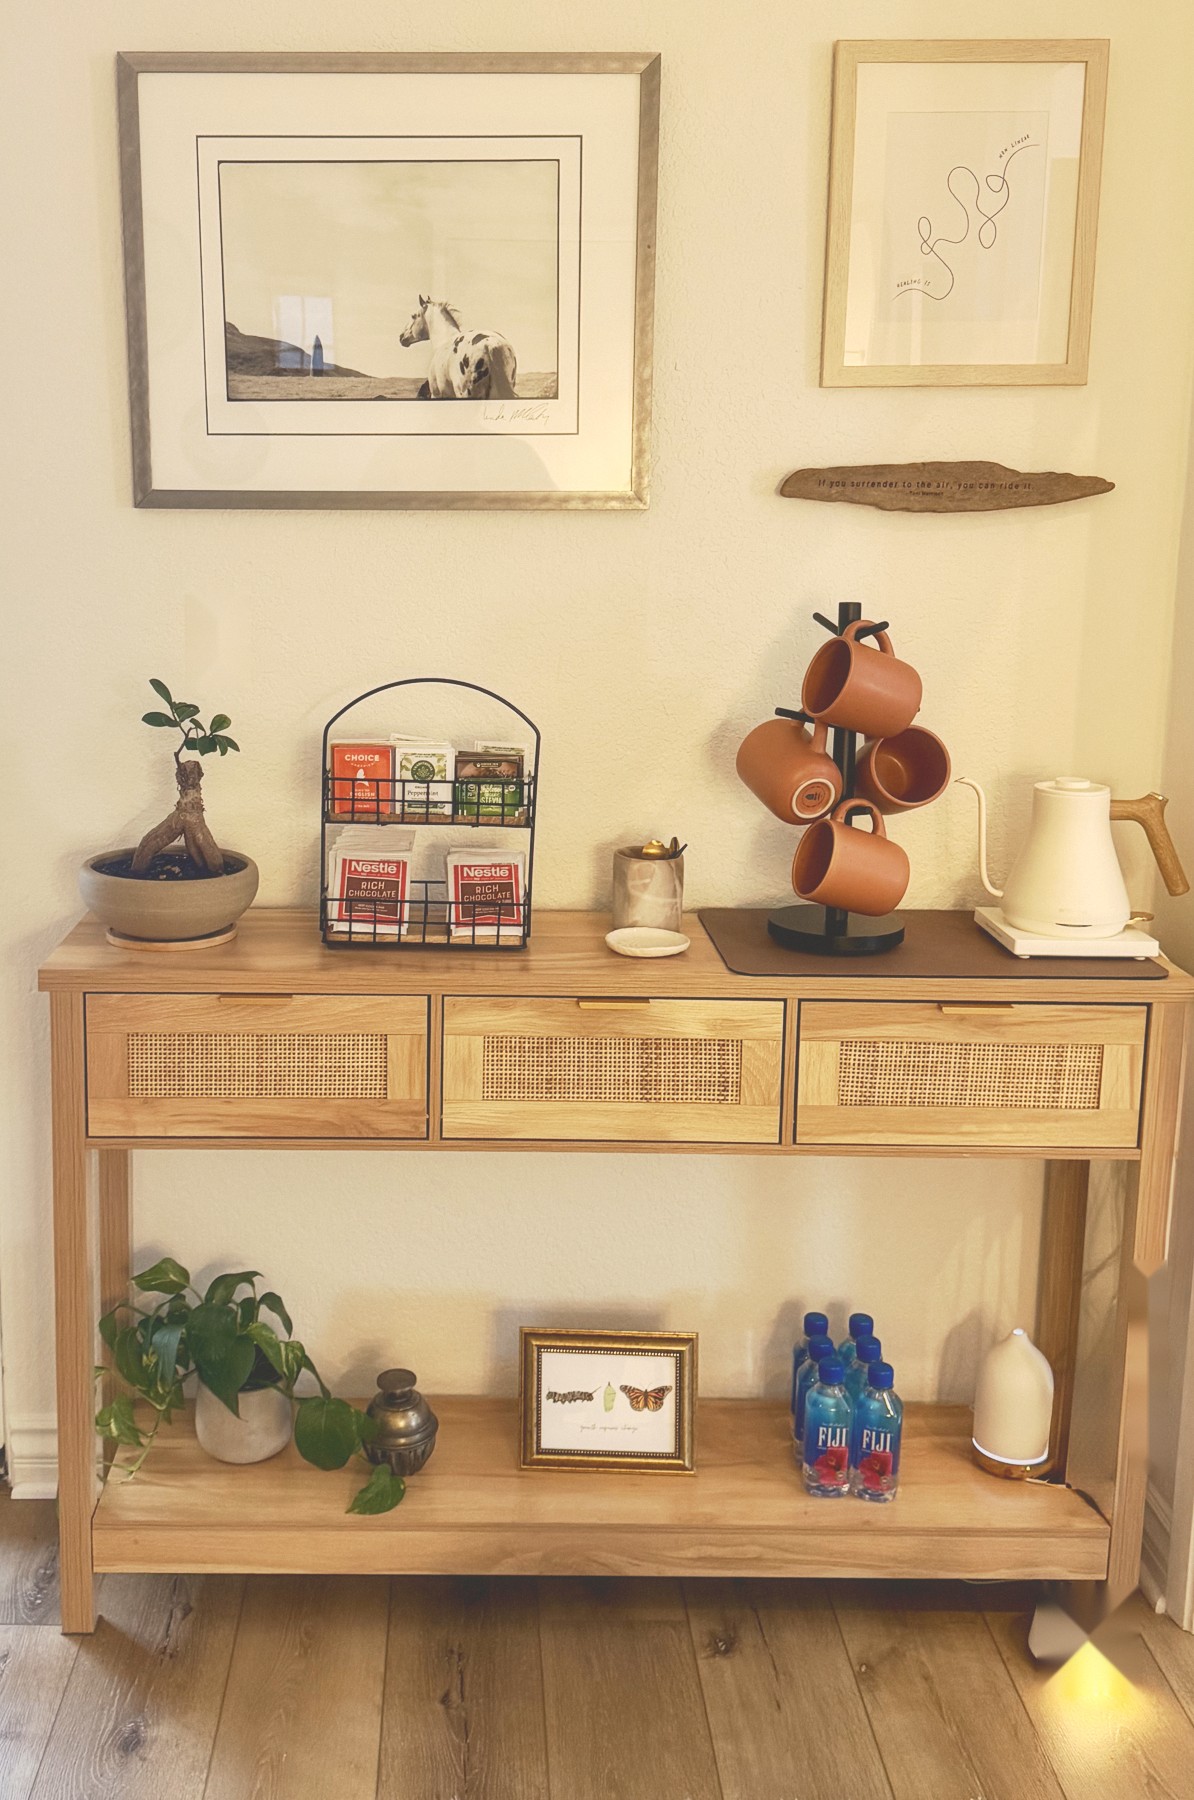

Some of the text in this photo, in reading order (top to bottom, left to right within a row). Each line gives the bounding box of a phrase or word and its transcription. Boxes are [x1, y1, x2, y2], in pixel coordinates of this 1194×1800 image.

[829, 480, 847, 489] you
[850, 480, 898, 489] surrender
[902, 481, 912, 489] to
[916, 480, 932, 489] the
[957, 481, 974, 490] you
[978, 482, 996, 490] can
[999, 482, 1020, 490] ride
[344, 754, 380, 762] CHOICE
[361, 881, 385, 890] RICH
[475, 884, 499, 894] RICH
[348, 889, 397, 898] CHOCOLATE
[463, 891, 512, 902] CHOCOLATE
[818, 1426, 847, 1447] FIJI
[862, 1429, 891, 1453] FIJI
